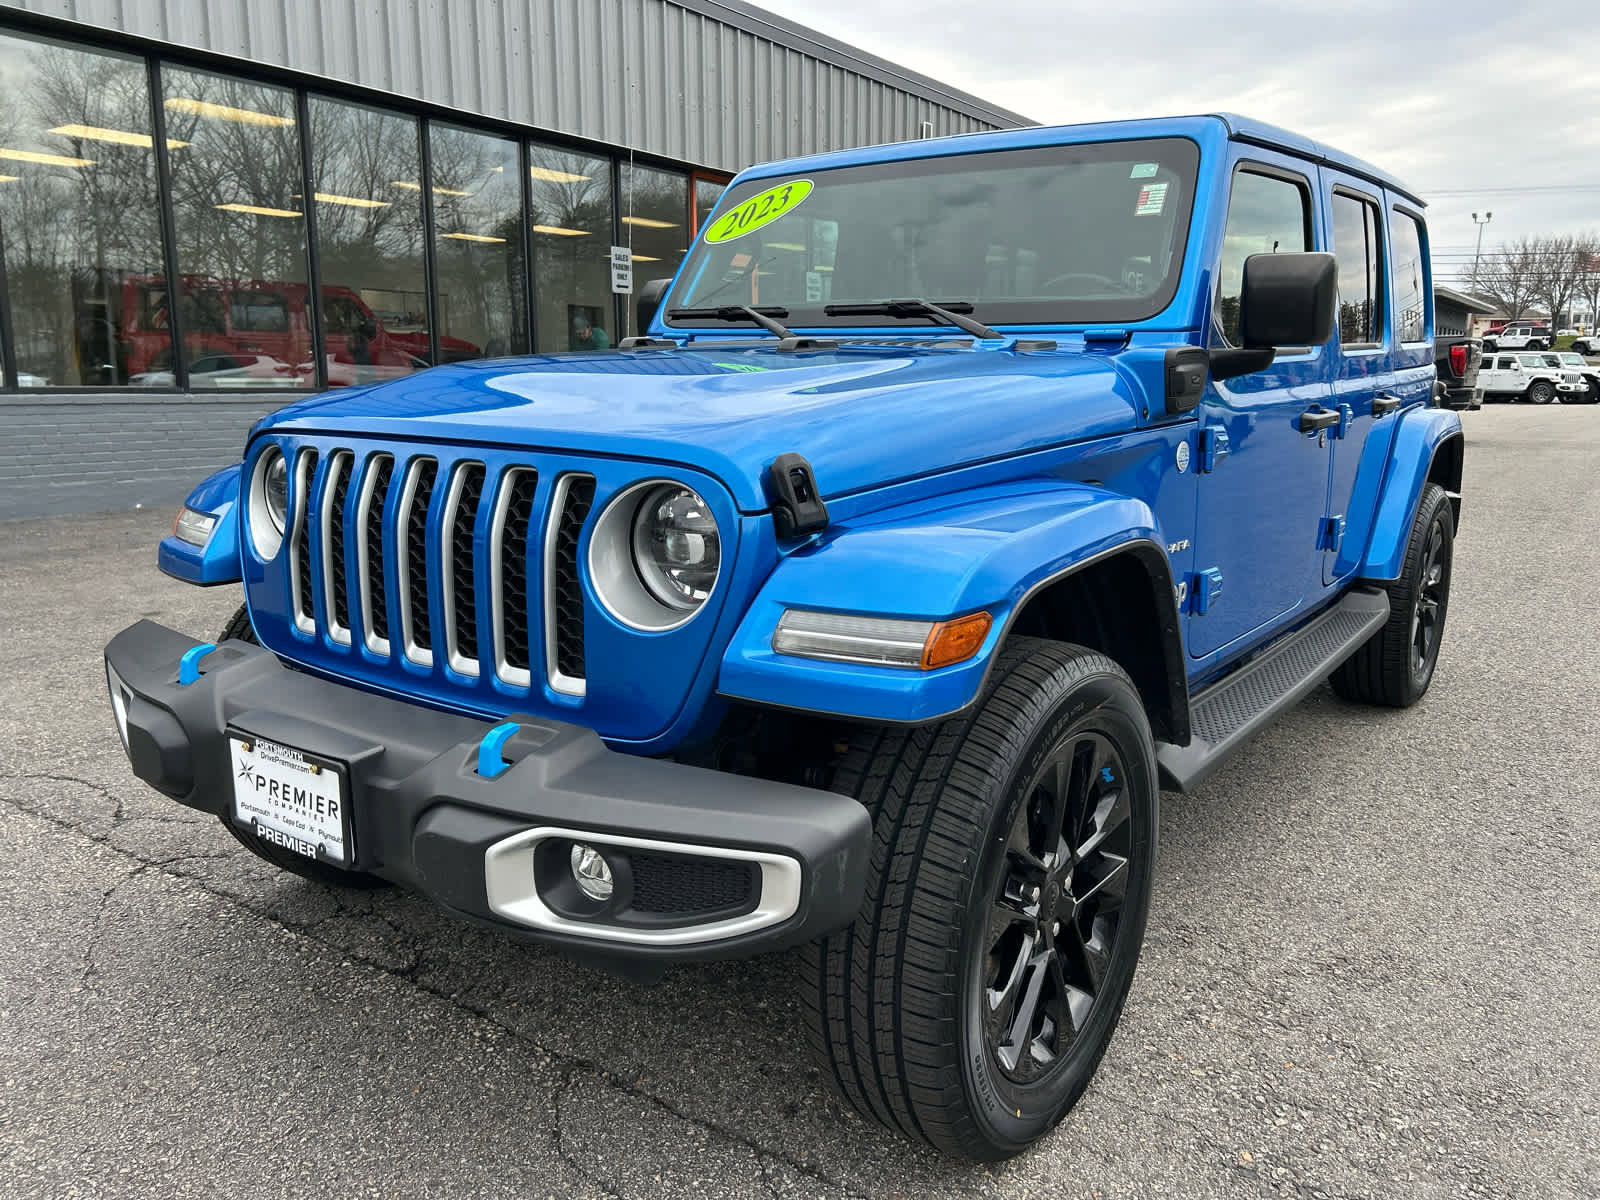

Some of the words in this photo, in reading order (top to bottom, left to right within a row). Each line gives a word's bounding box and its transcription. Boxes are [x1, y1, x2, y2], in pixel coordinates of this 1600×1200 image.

[719, 184, 794, 240] 2023
[255, 739, 304, 763] PORTSMOUTH
[256, 774, 338, 820] PREMIER
[268, 797, 325, 823] COMPANIES
[256, 824, 317, 860] PREMIER
